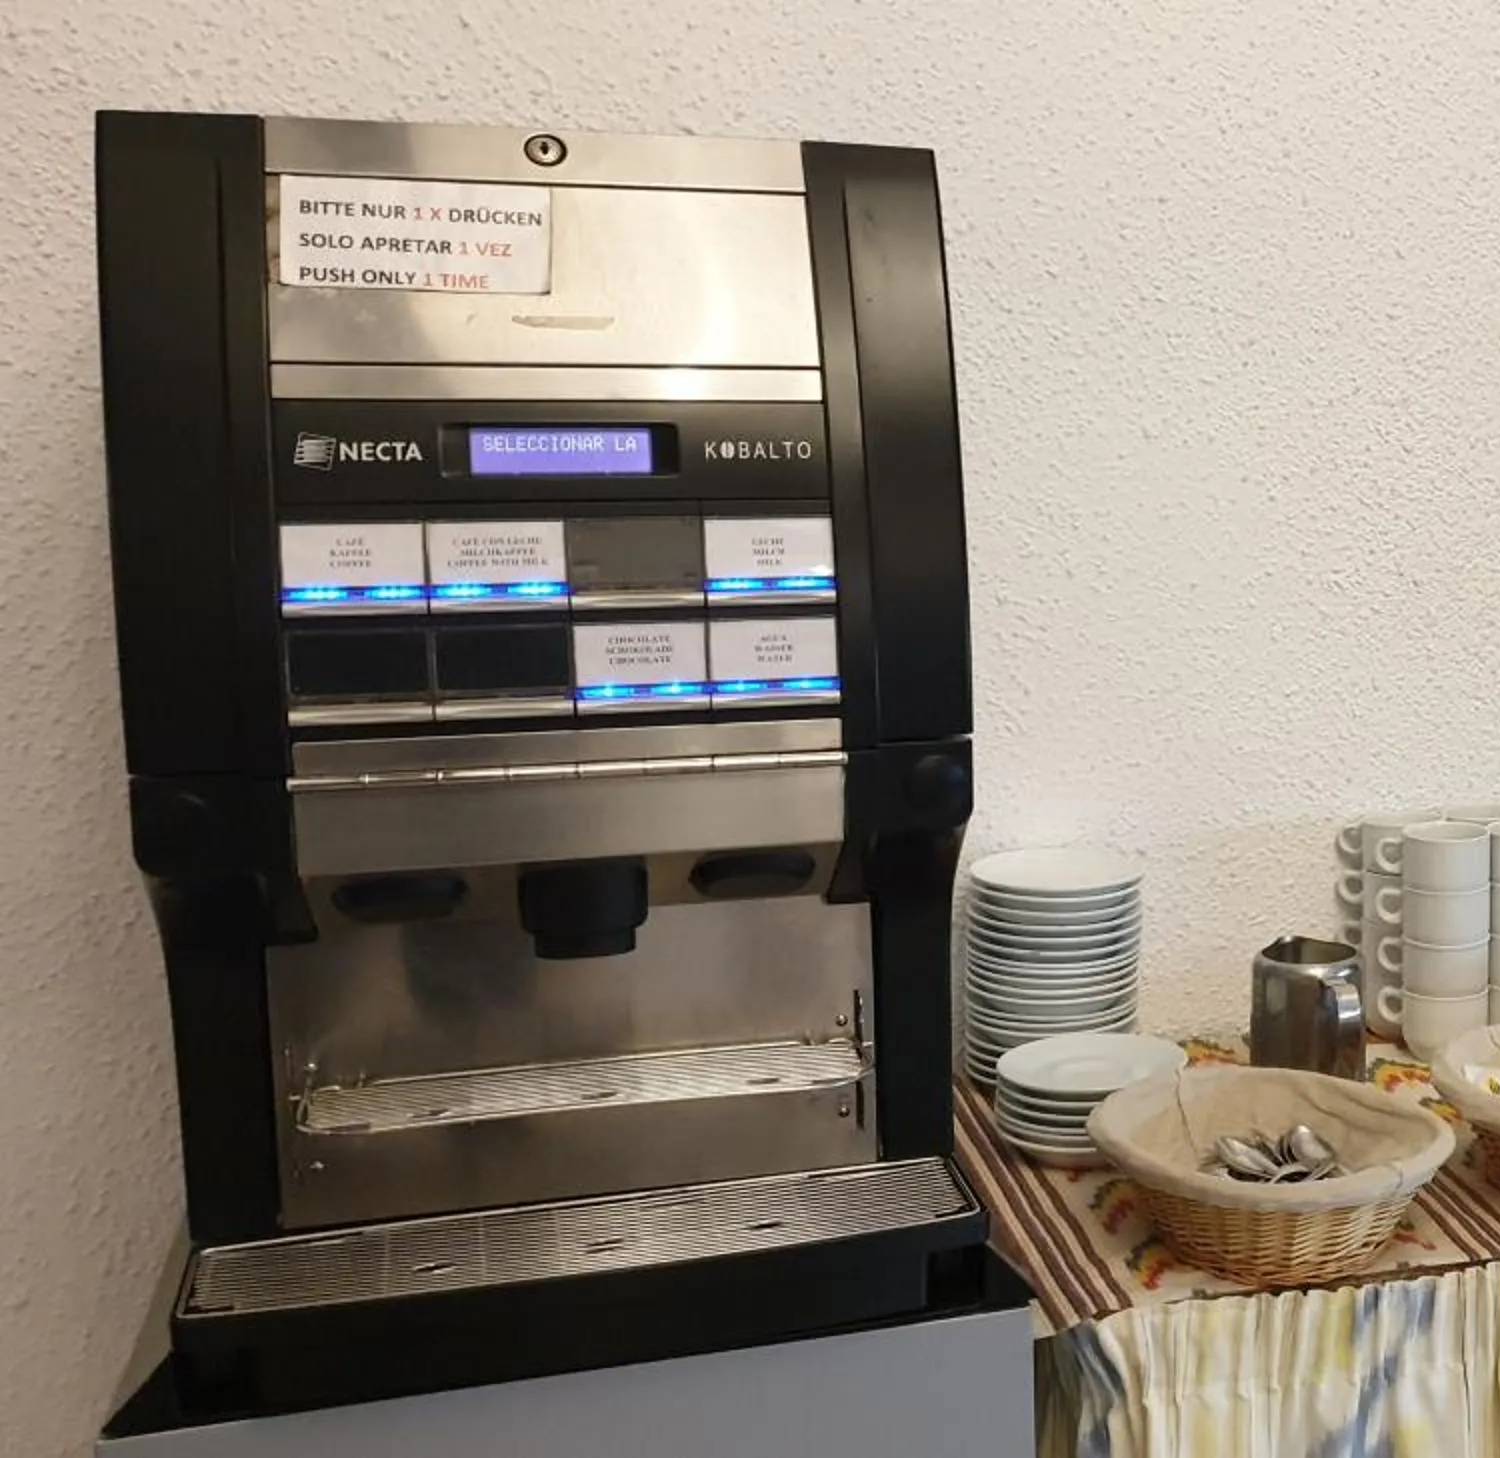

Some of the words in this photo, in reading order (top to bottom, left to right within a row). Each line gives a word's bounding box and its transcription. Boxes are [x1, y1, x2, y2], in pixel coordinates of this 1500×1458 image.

[299, 199, 355, 217] BITTE
[361, 203, 406, 220] NUR
[413, 207, 423, 221] 1
[429, 207, 443, 221] X
[449, 207, 543, 226] DRÜCKEN
[299, 233, 354, 249] SOLO
[360, 236, 452, 255] APRETAR
[458, 242, 469, 255] 1
[475, 243, 512, 257] VEZ
[299, 266, 355, 284] PUSH
[361, 269, 417, 286] ONLY
[423, 272, 433, 287] 1
[439, 273, 490, 289] TIME
[339, 442, 424, 462] NECTA
[482, 434, 605, 454] SELECCIONAR
[614, 436, 637, 453] LA
[704, 441, 812, 460] KOBALTO
